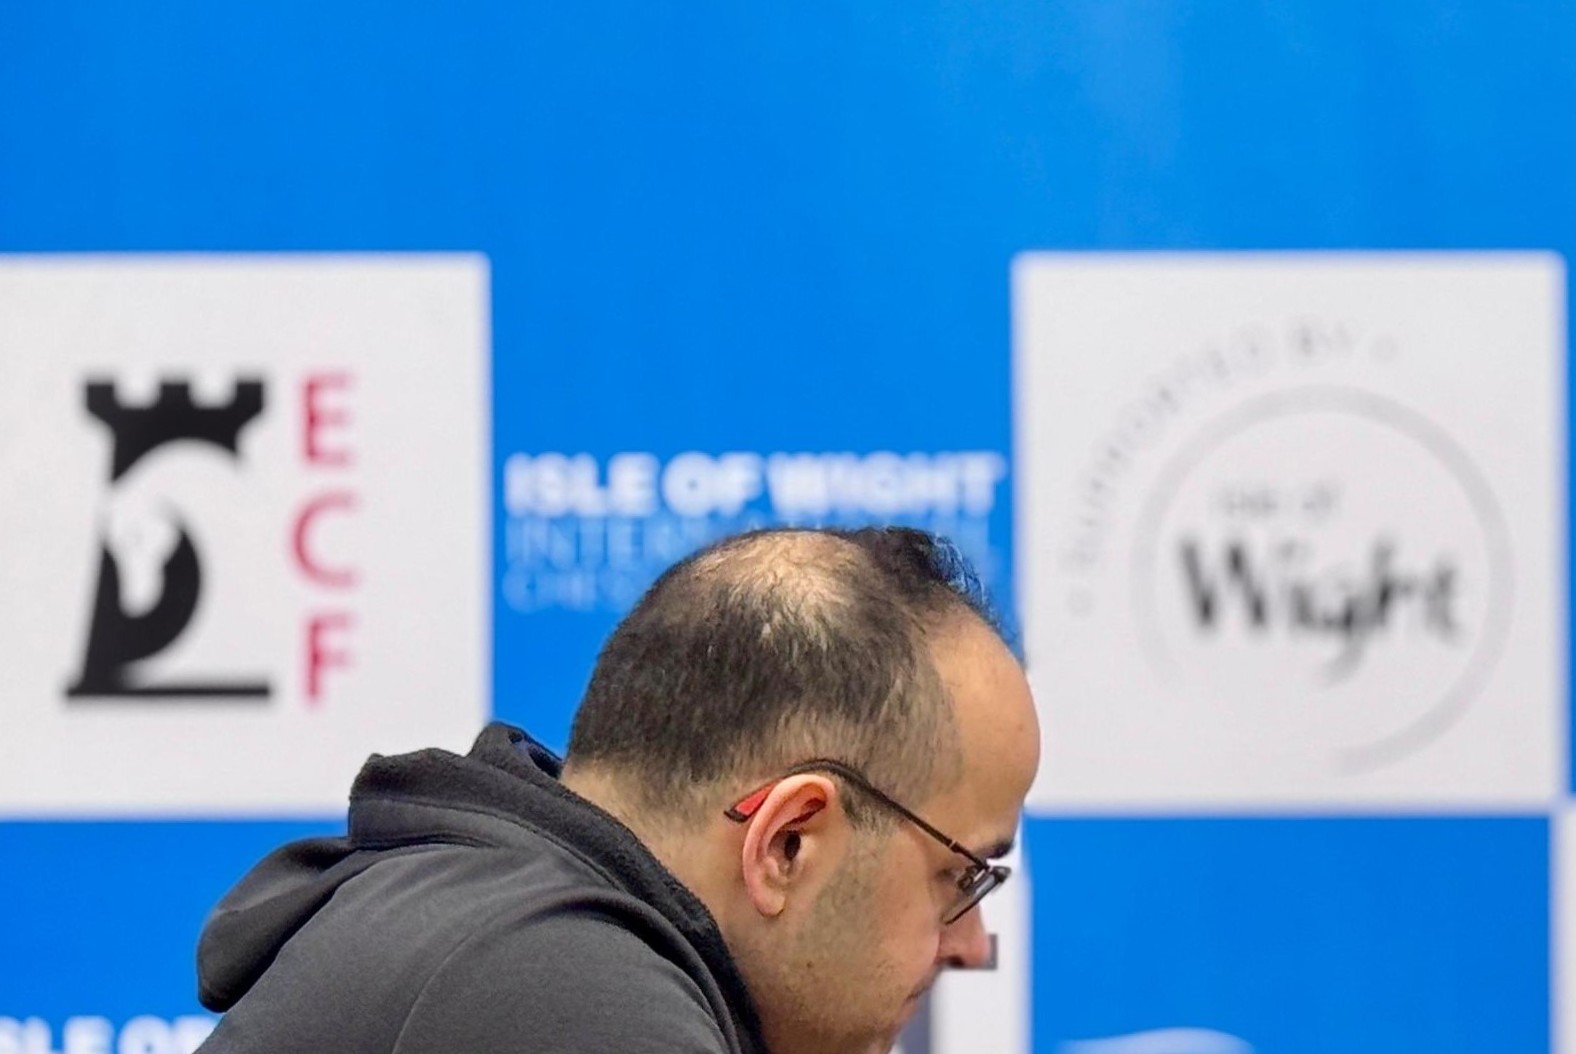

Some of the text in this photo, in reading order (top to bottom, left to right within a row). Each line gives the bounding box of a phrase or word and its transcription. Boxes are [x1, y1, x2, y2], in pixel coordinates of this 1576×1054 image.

[504, 451, 1007, 518] ISLE OF WIGHT
[1178, 533, 1464, 686] Wight
